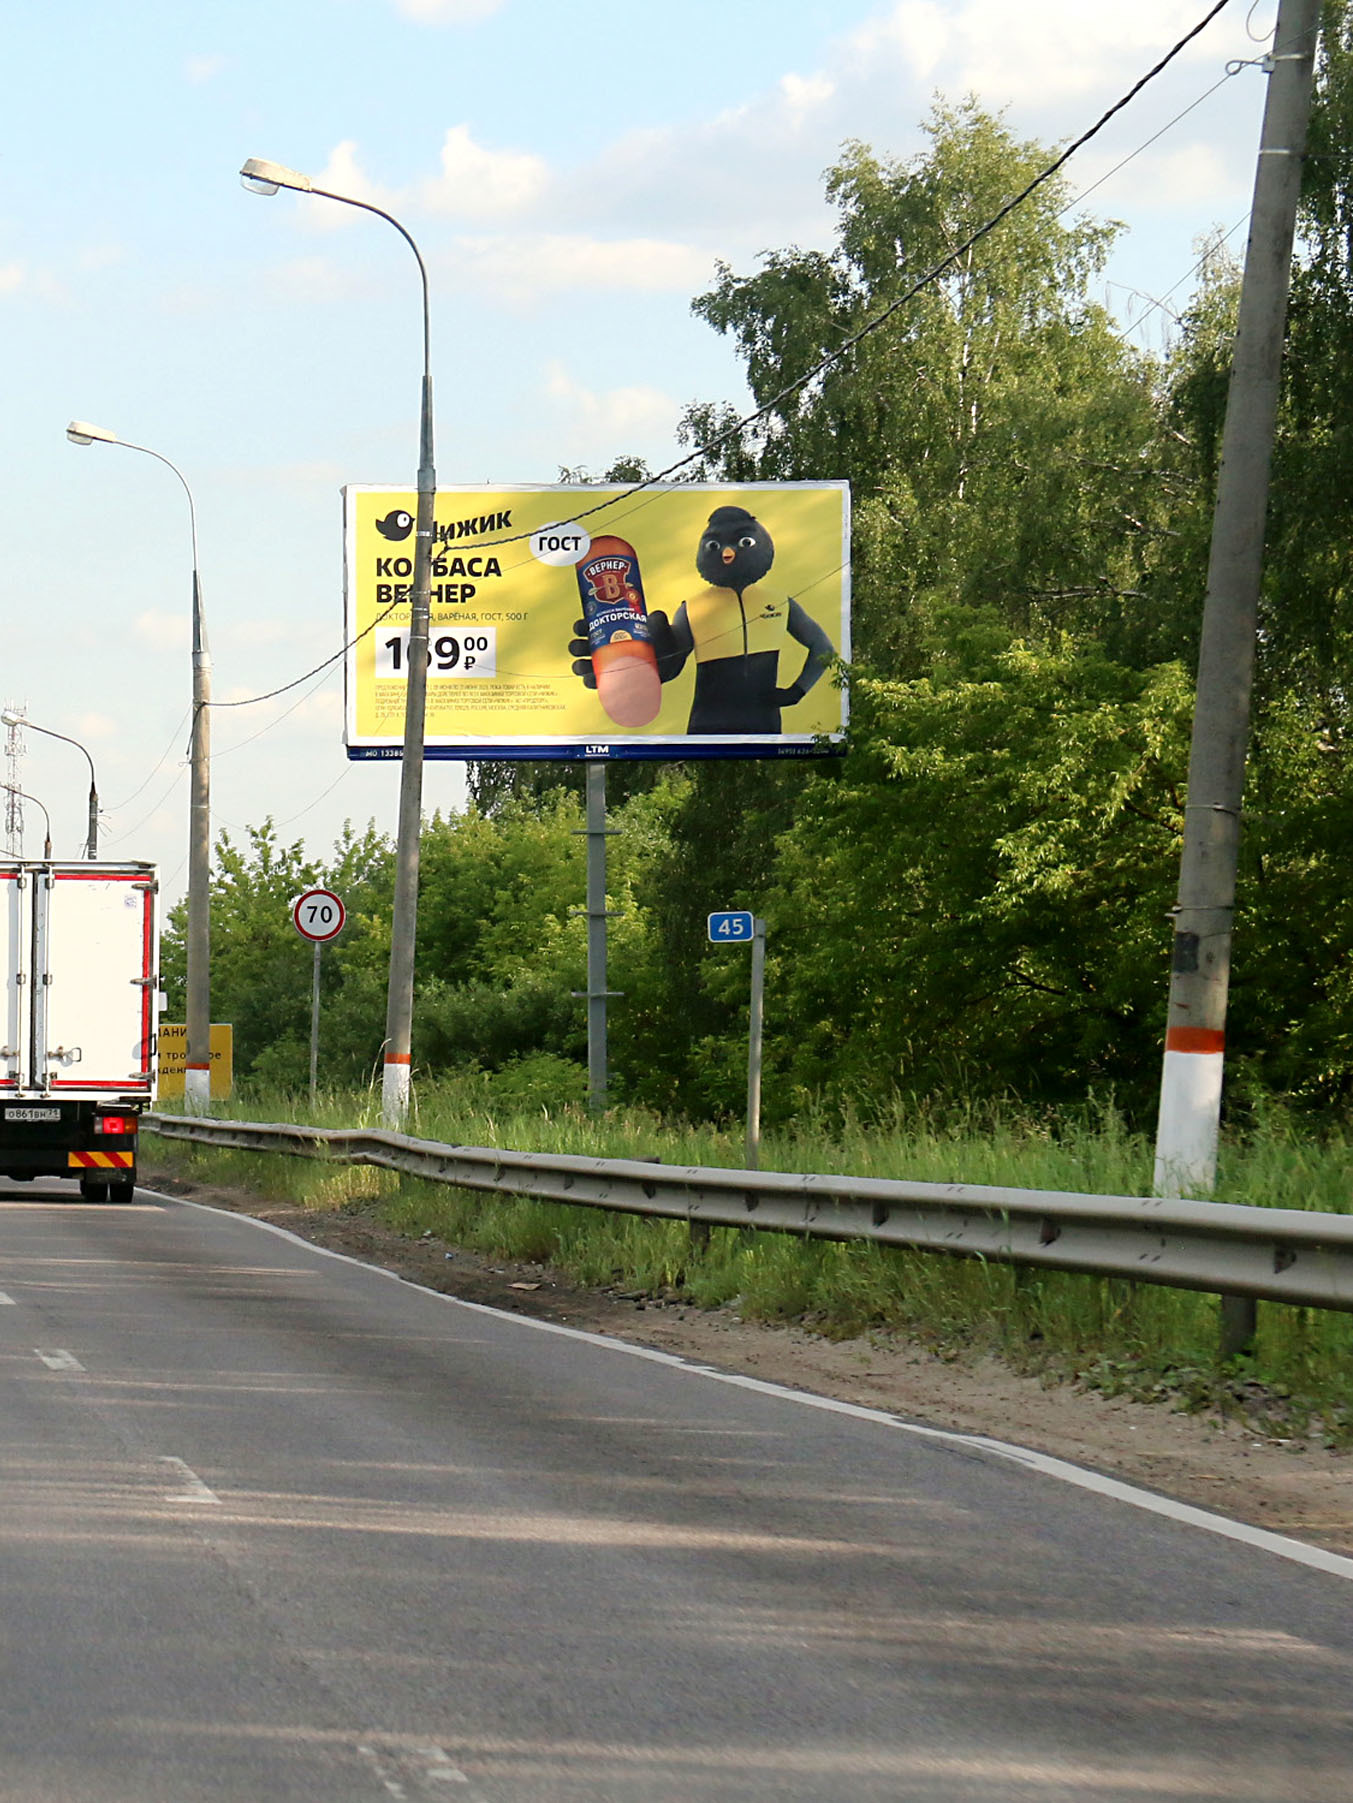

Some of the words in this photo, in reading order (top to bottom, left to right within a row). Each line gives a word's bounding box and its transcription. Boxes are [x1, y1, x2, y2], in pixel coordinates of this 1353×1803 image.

[539, 536, 582, 551] ГОСТ
[376, 557, 502, 577] КОБАСА
[589, 560, 625, 576] ВЕРНЕР
[376, 584, 476, 603] ВЕНЕР
[376, 612, 436, 621] ДОКТОРЯ,
[506, 612, 521, 621] 500
[589, 612, 647, 632] ДОКТОРСКАЯ
[464, 637, 488, 651] 00
[585, 745, 609, 754] LTM
[307, 906, 332, 923] 70
[718, 919, 744, 935] 45
